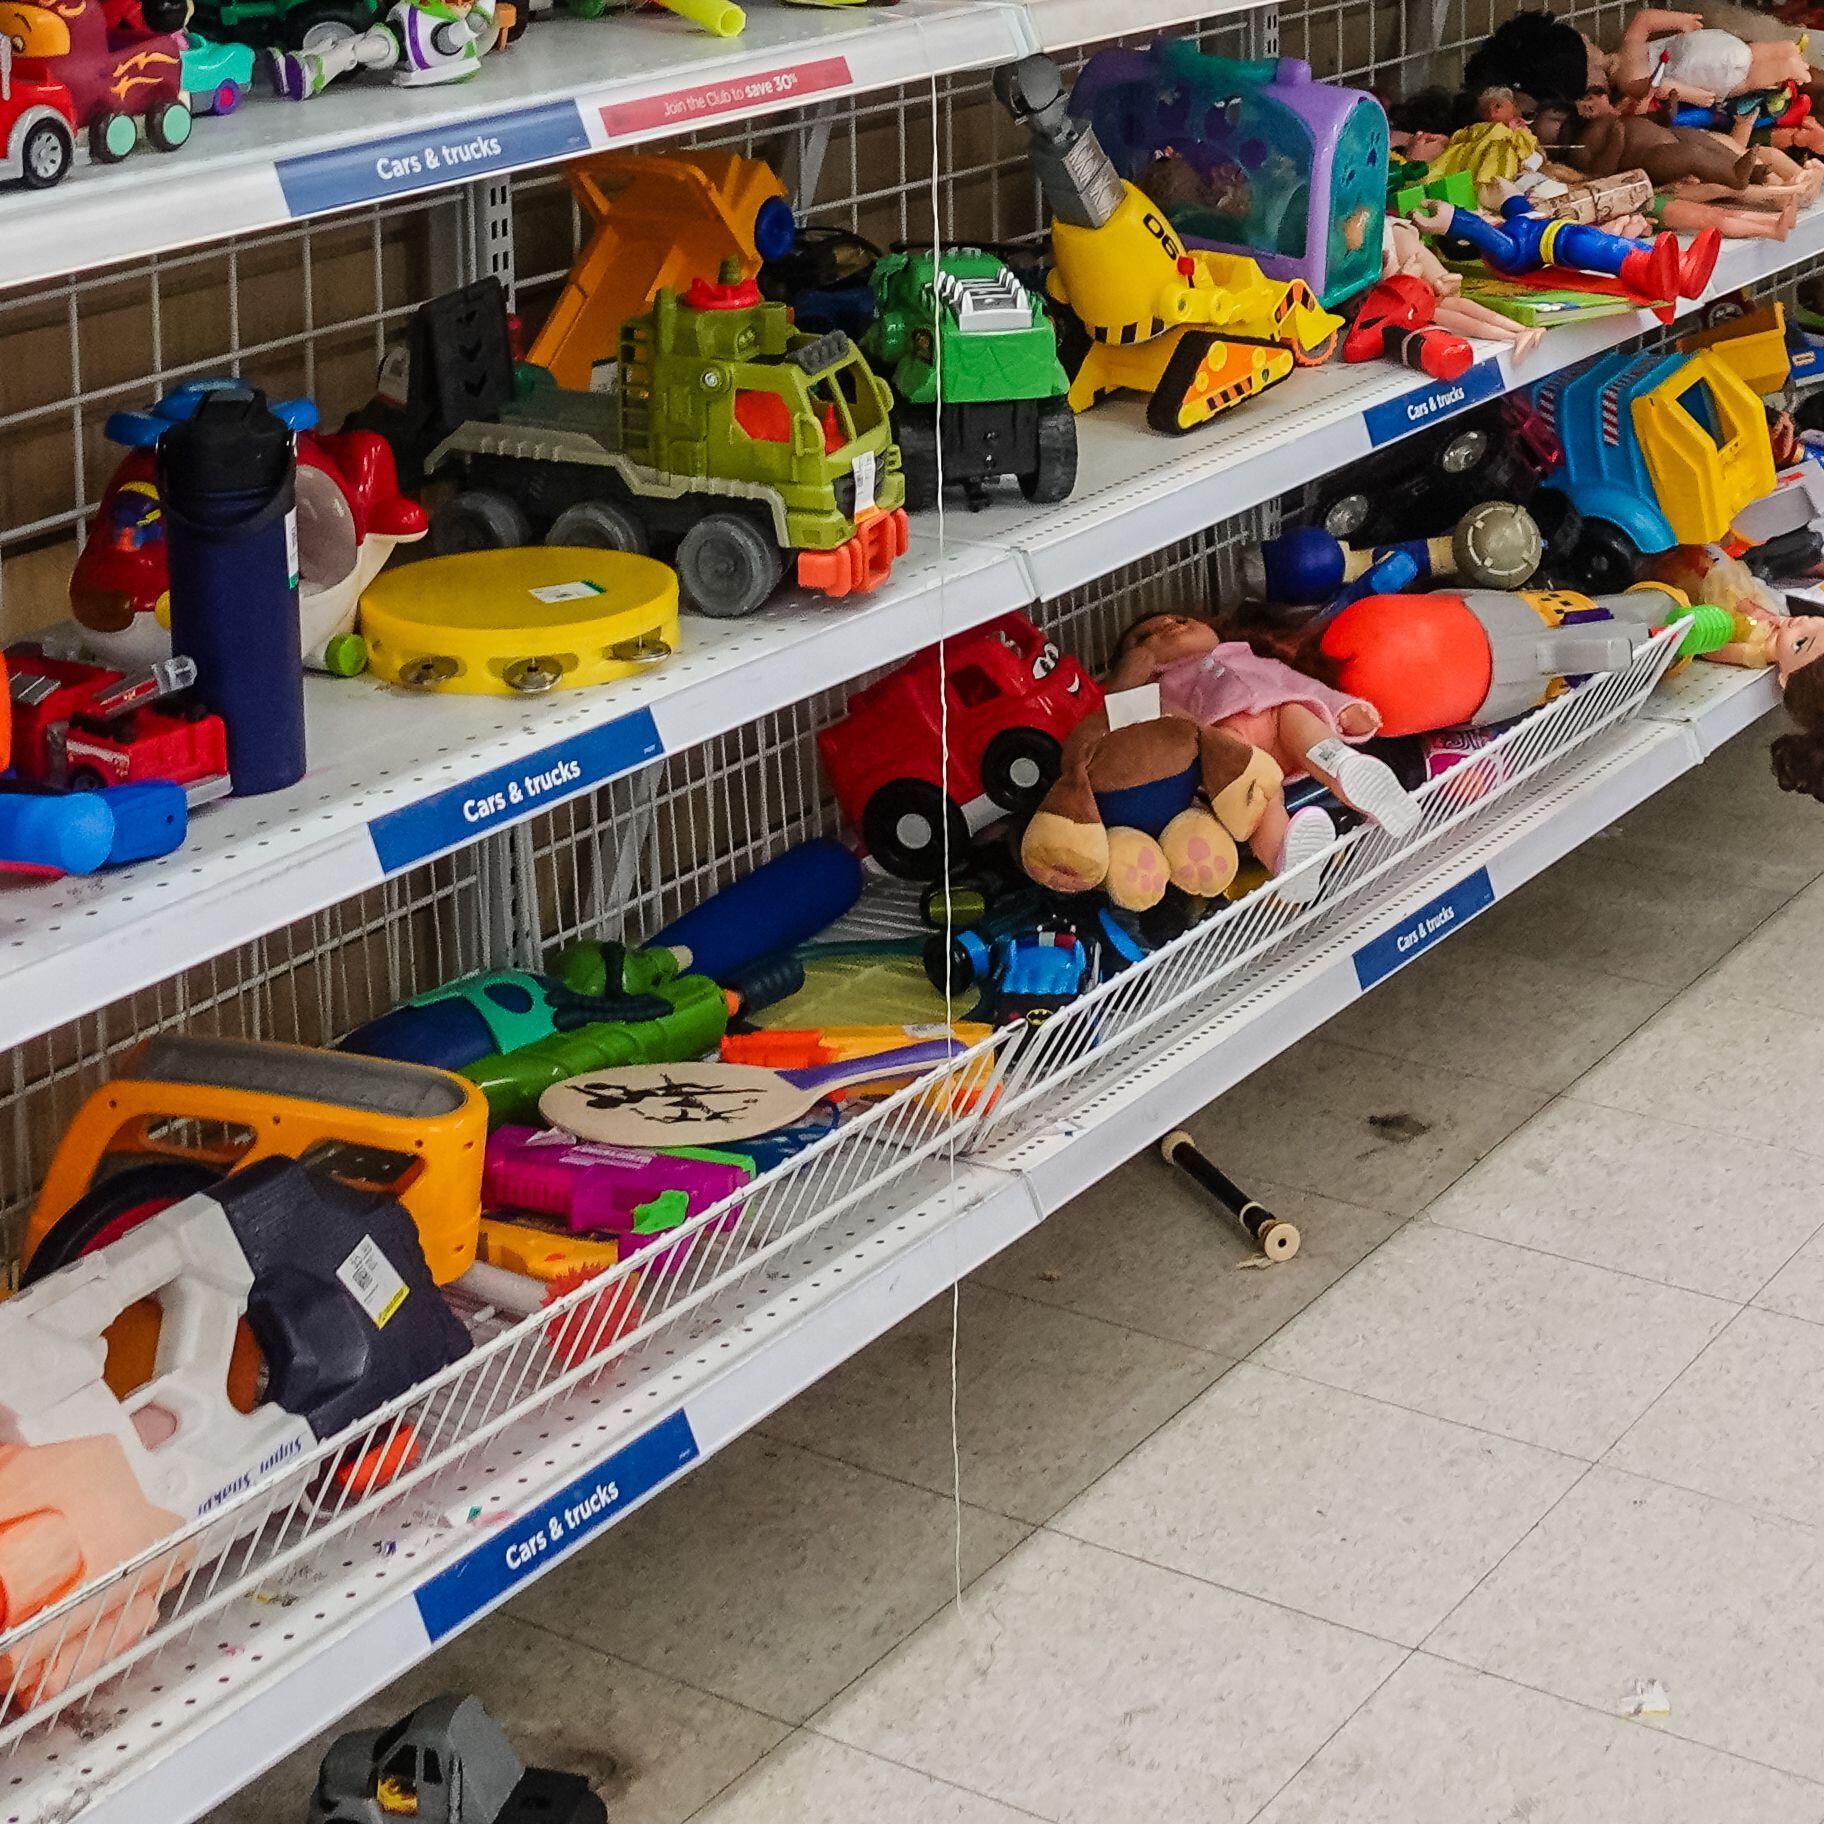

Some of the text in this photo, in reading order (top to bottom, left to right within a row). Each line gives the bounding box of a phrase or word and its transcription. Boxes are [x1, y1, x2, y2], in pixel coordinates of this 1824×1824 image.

[664, 72, 798, 117] Join the Club to save 30%
[376, 135, 502, 180] Cars & trucks
[1407, 386, 1465, 421] Cars & trucks
[463, 760, 582, 822] Cars & trucks
[1396, 906, 1455, 953] Cars & trucks
[505, 1480, 620, 1570] Cars & trucks
